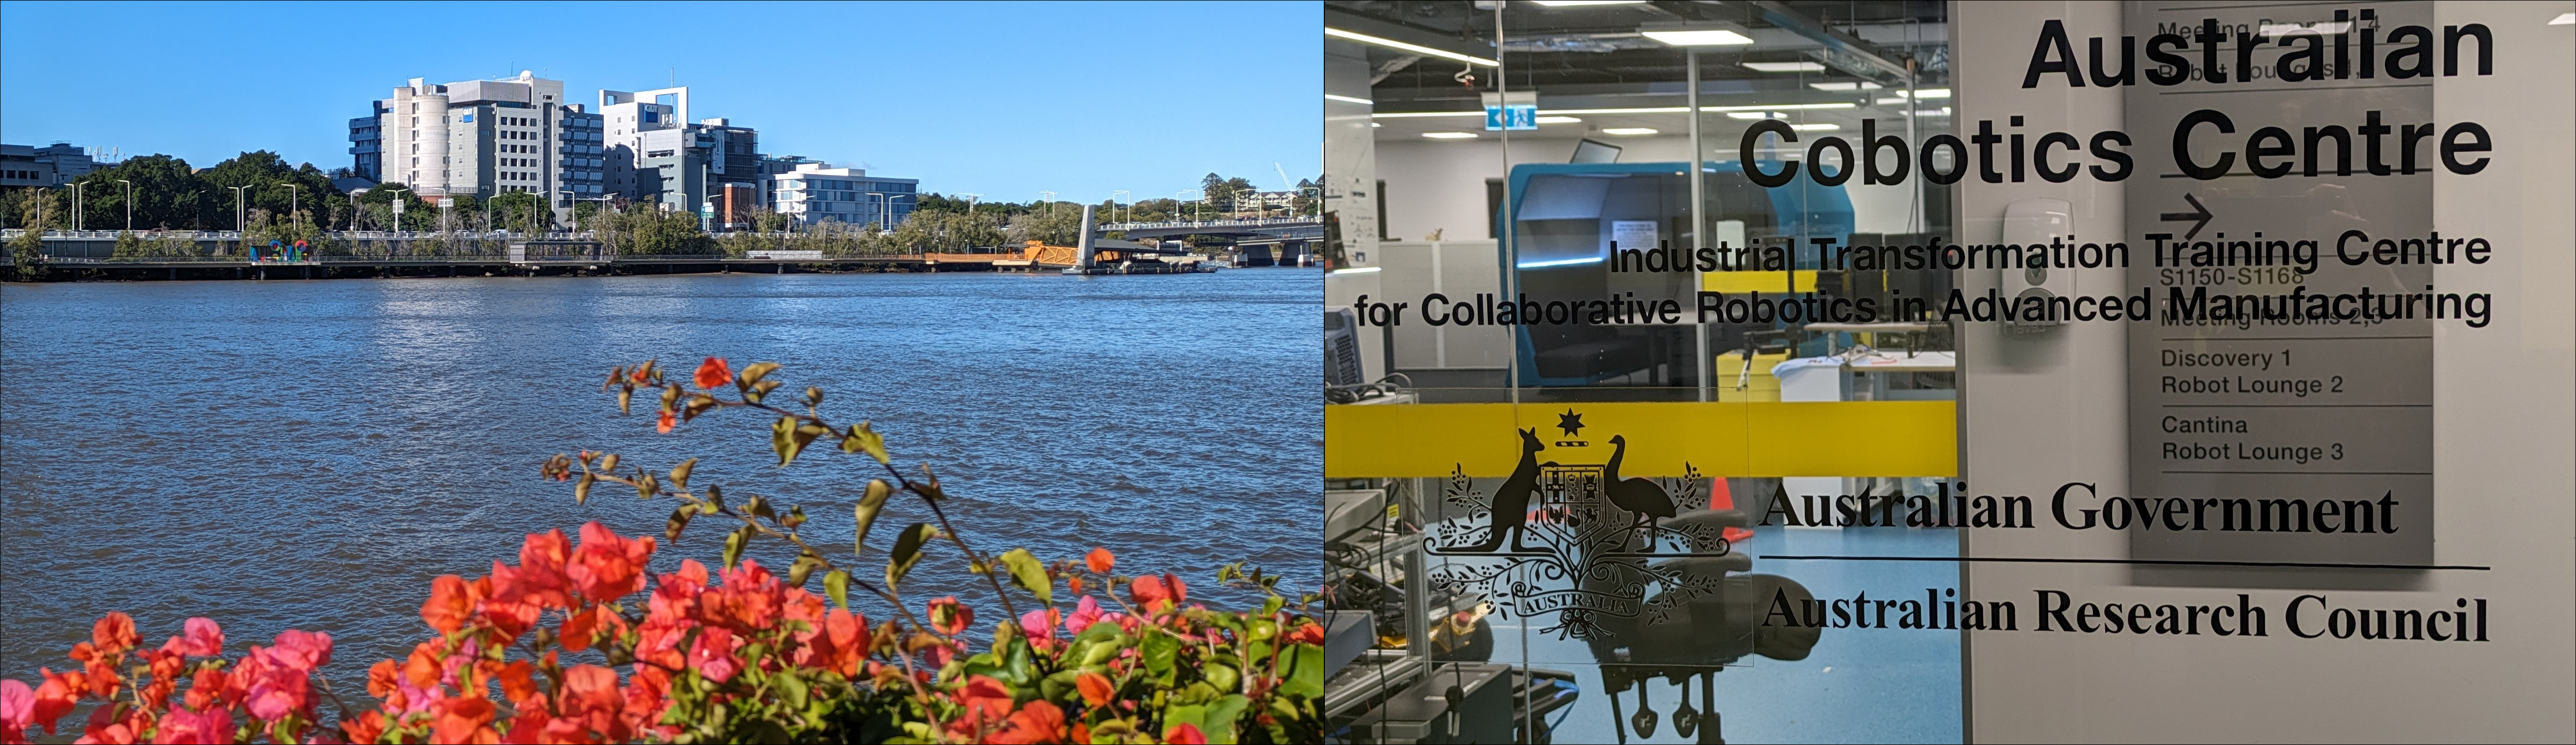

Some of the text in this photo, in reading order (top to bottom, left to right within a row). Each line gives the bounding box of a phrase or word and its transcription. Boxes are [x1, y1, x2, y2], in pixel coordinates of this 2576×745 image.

[2158, 20, 2248, 42] Meein
[2022, 9, 2493, 89] Australian
[1739, 110, 2492, 187] Cobotics Centre
[1610, 230, 2492, 274] Industrial Transformation Training Centre
[2160, 267, 2304, 285] S1150-S1168
[1354, 286, 2492, 328] for Collaborative Robotics in Advanced Manufacturing
[2161, 349, 2290, 370] Discovery 1
[2162, 376, 2343, 397] Robot Lounge 2
[2162, 416, 2248, 433] Cantina
[2162, 443, 2344, 464] Robot Lounge 3
[1759, 480, 2400, 534] Australian Government
[1523, 593, 1629, 614] AUSTRALIA
[1761, 586, 2491, 642] Australian Research Council
